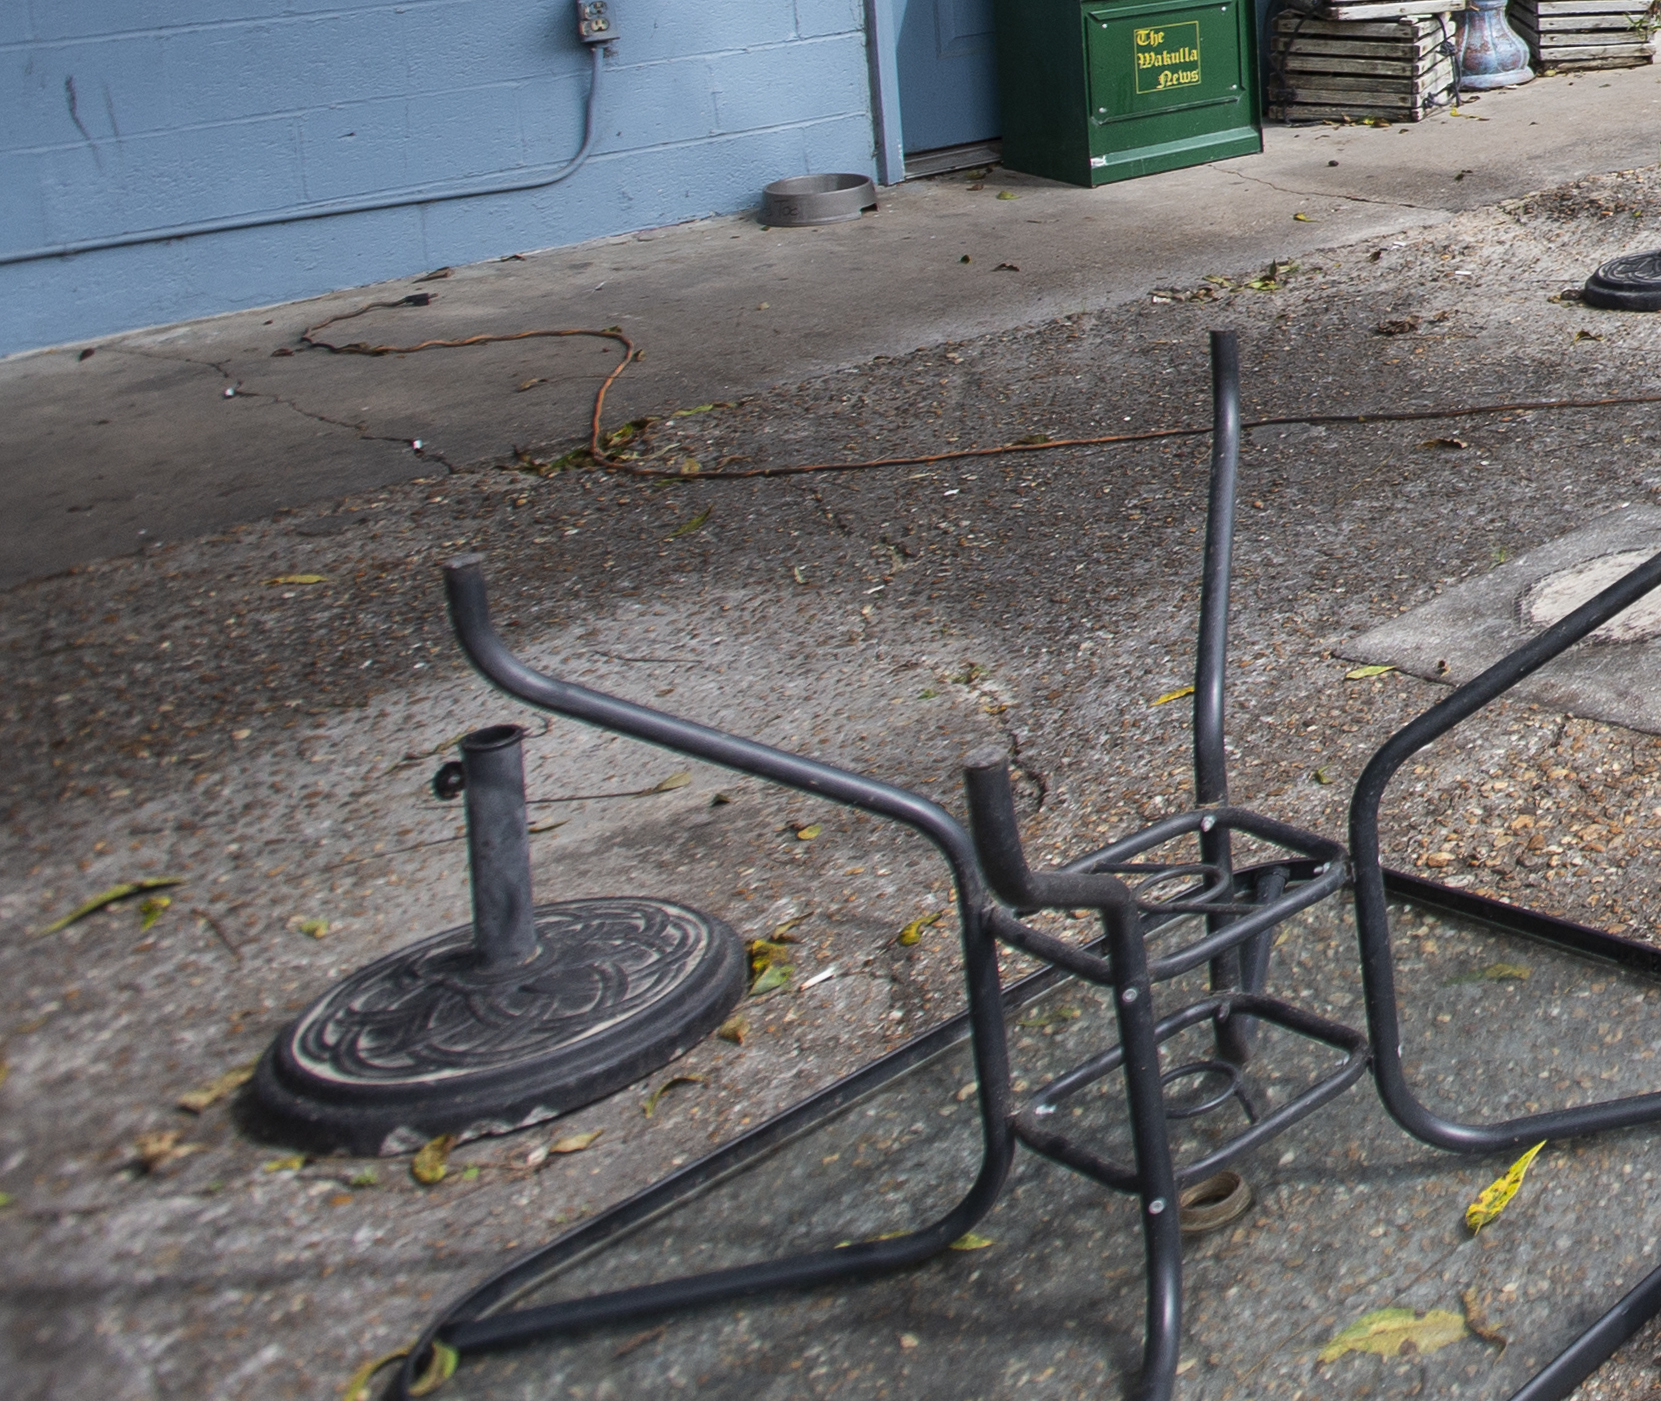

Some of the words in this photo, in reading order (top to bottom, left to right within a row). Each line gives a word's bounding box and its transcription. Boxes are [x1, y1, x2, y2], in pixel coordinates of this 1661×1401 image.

[1135, 30, 1165, 47] The
[1137, 47, 1198, 69] Wakulla
[1156, 69, 1199, 89] News
